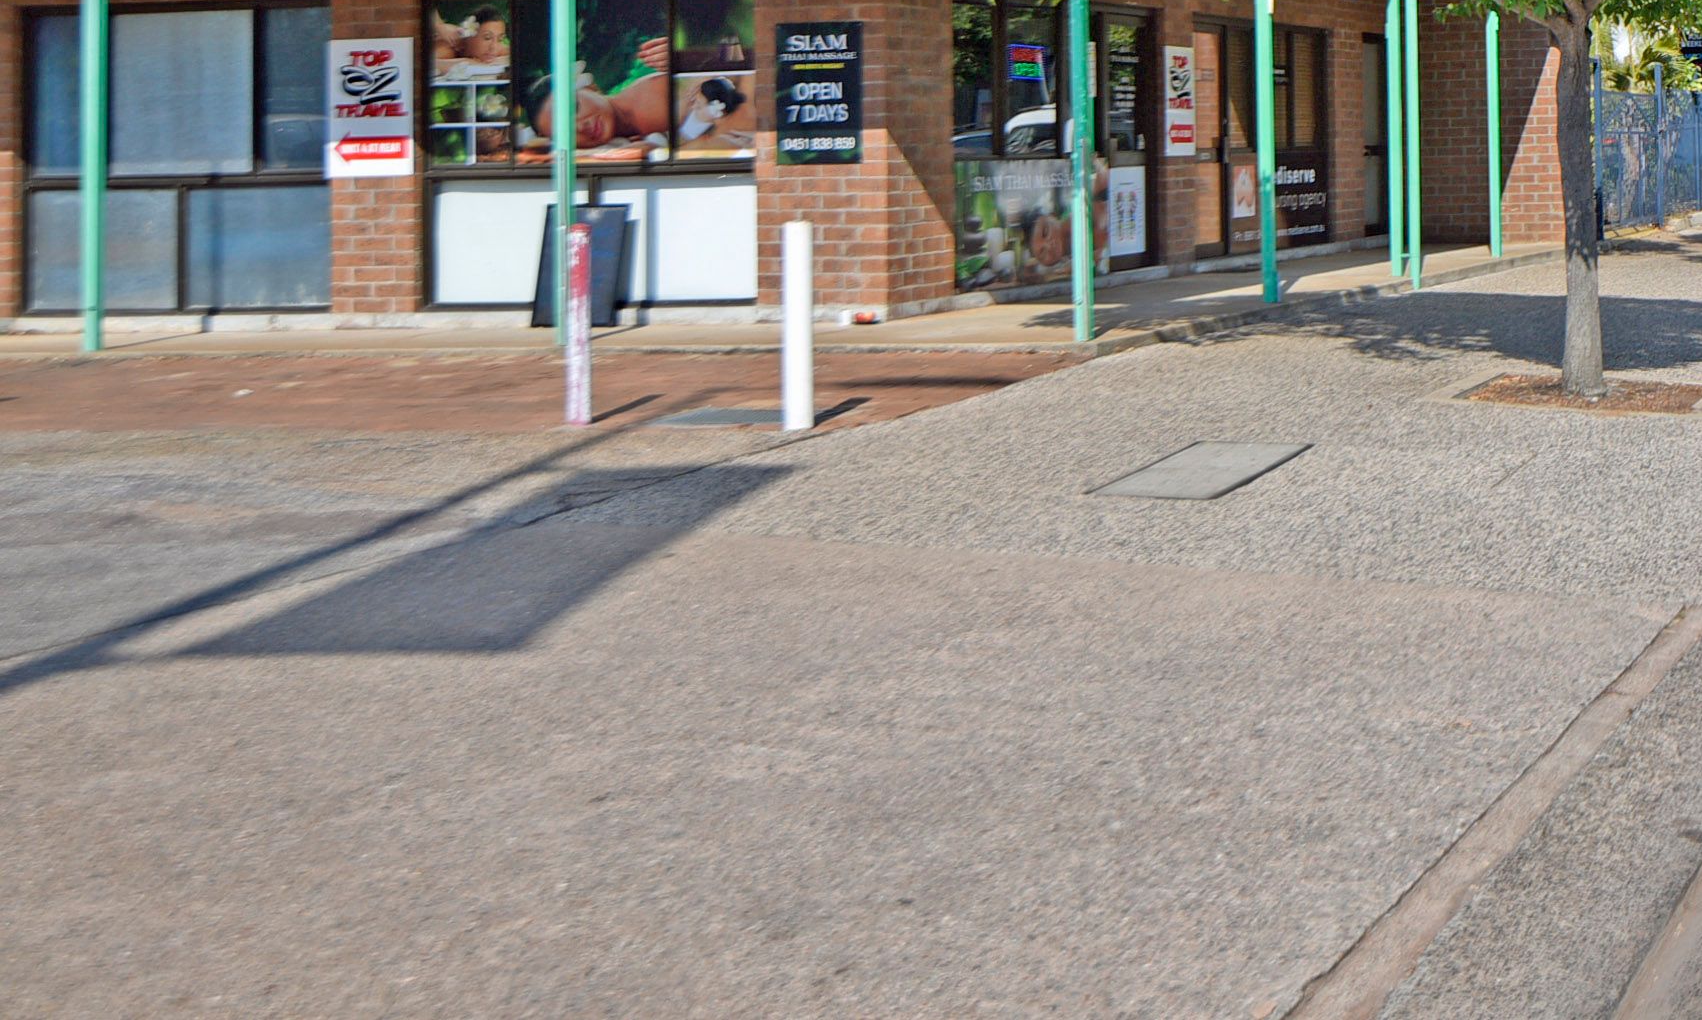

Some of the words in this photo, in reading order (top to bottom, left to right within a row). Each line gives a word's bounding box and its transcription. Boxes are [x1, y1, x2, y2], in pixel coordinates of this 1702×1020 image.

[786, 33, 848, 52] SIAM
[348, 50, 394, 67] TOP
[781, 53, 806, 61] THAI
[807, 51, 858, 61] MASSAGE
[1172, 55, 1189, 69] TOP
[795, 81, 843, 101] OPEN
[335, 102, 409, 118] TRAVEL
[1169, 97, 1193, 110] TRAVEL
[786, 105, 800, 123] 7
[802, 103, 849, 123] DAYS
[782, 138, 809, 151] 0451
[833, 137, 856, 150] 859
[973, 176, 1003, 191] SIAM
[1005, 174, 1032, 189] THAI
[1035, 172, 1074, 188] MASSA
[1274, 166, 1316, 185] diserve
[1299, 192, 1327, 210] agency
